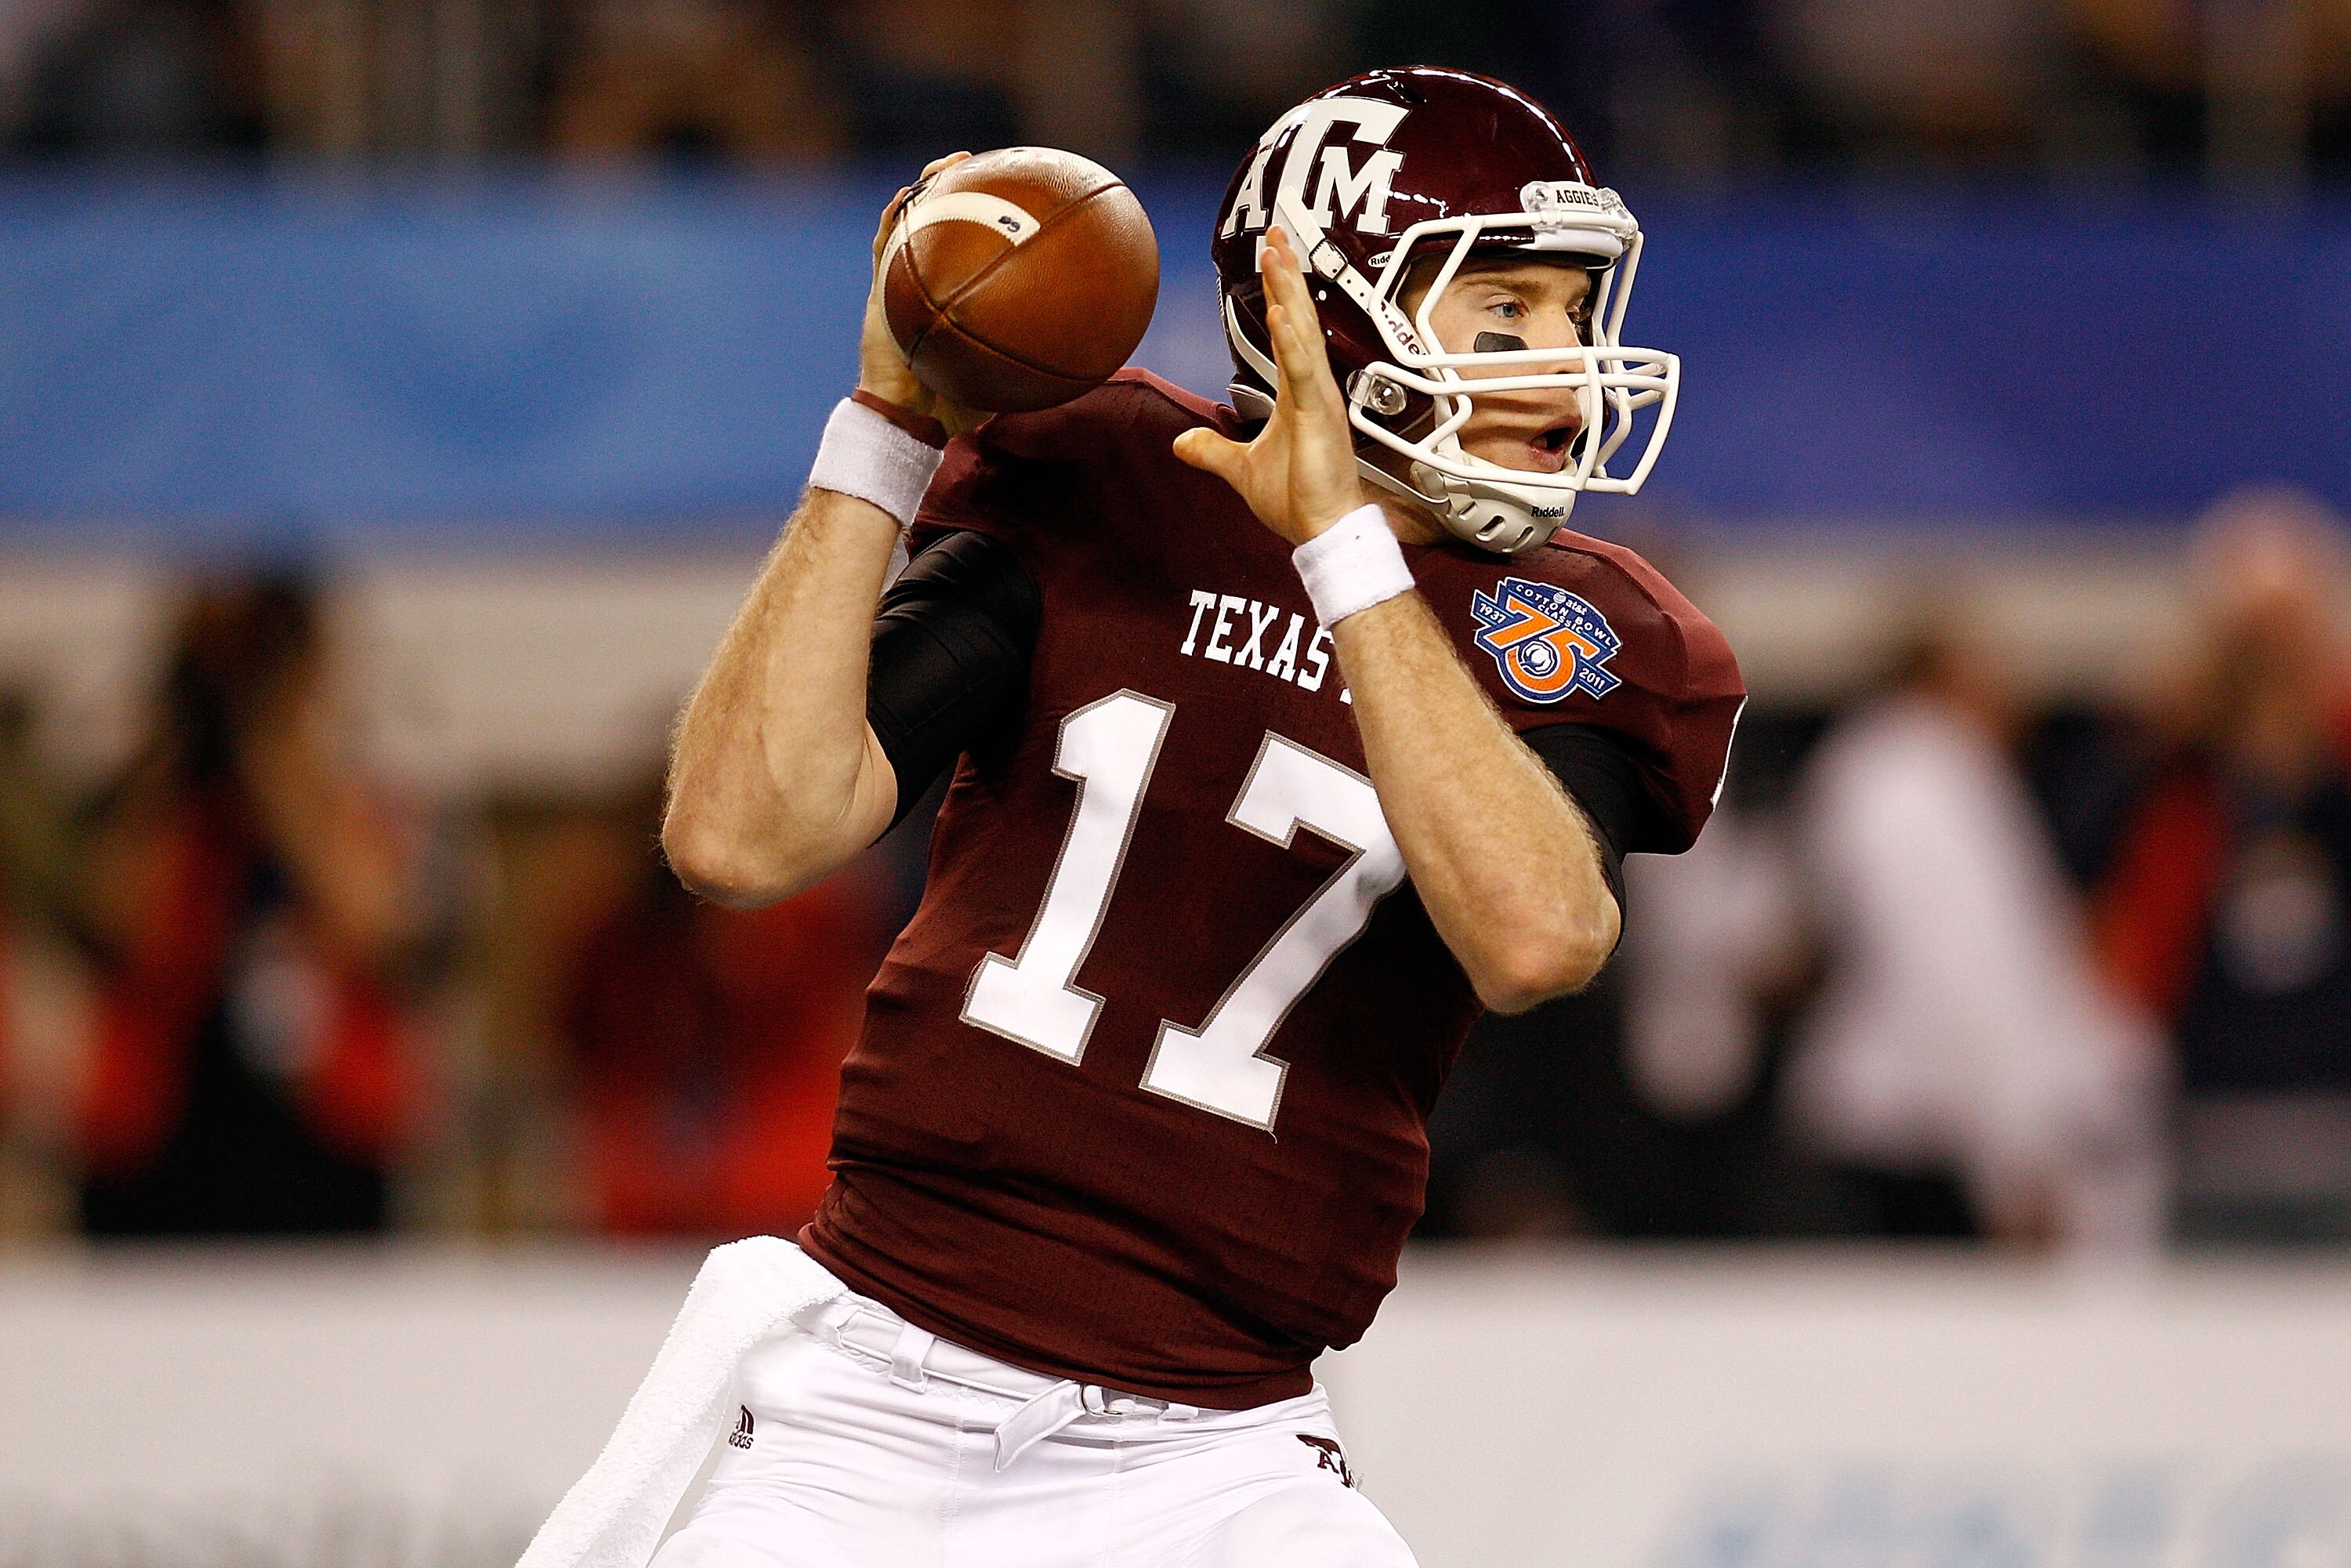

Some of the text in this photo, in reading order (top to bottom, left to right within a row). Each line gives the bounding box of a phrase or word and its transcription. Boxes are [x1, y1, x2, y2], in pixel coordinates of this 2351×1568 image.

[1556, 190, 1599, 207] AGGIES
[1371, 255, 1391, 266] Ridd
[1531, 505, 1564, 518] Riddell
[1480, 603, 1506, 624] 1937
[1516, 584, 1611, 646] COTTON BOWL
[1537, 604, 1585, 634] CLASSIC
[1180, 589, 1335, 692] TEXAS
[1483, 593, 1601, 694] 75
[1578, 668, 1606, 690] 2011
[958, 688, 1407, 1131] 17
